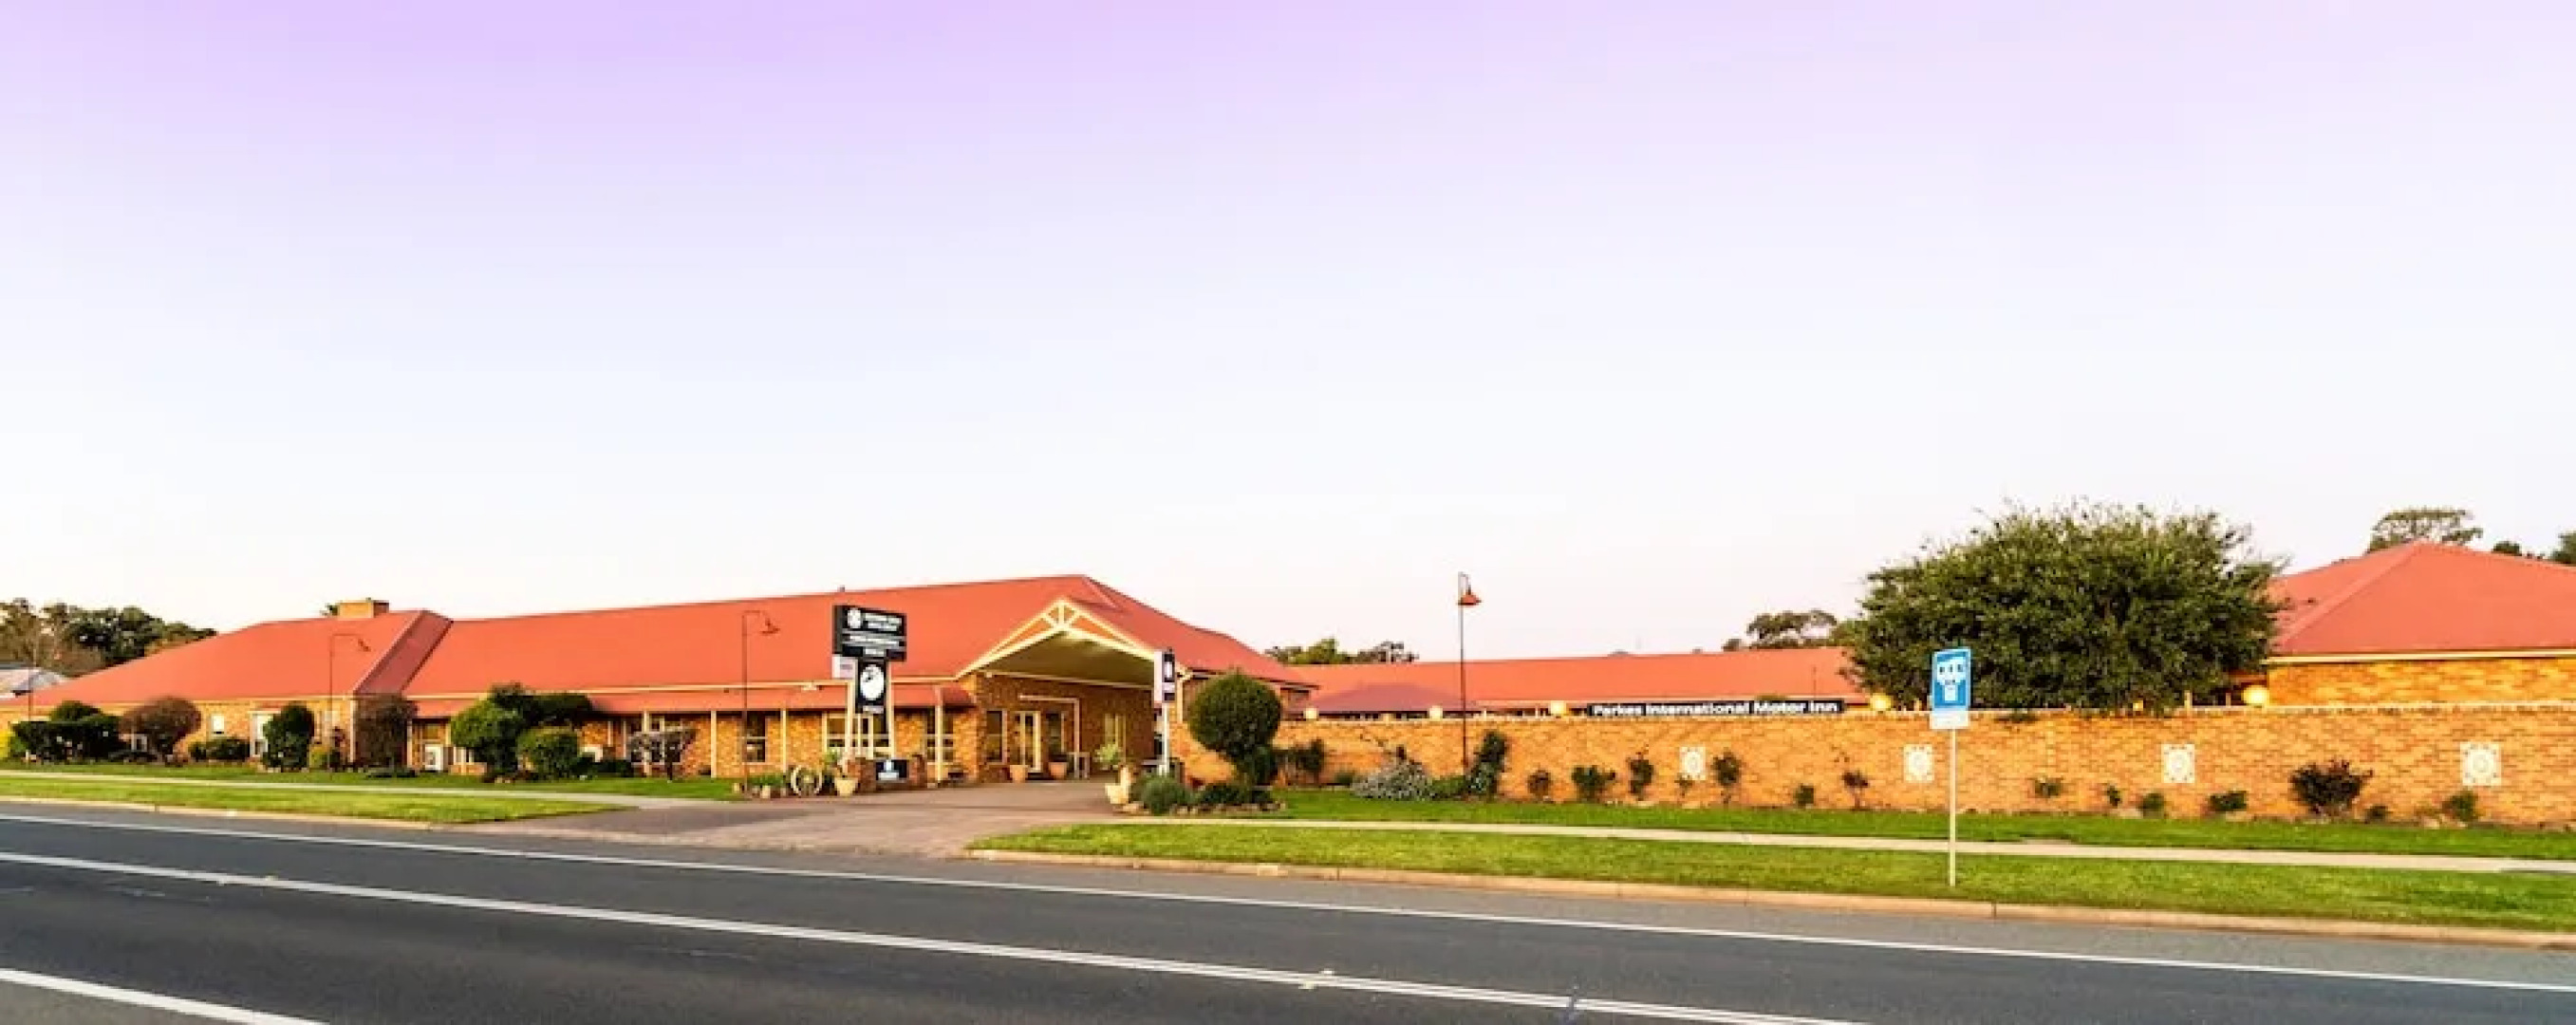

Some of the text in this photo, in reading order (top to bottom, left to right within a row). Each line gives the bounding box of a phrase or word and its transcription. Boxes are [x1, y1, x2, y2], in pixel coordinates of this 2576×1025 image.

[1594, 700, 1838, 716] Parkes International Motor Inn
